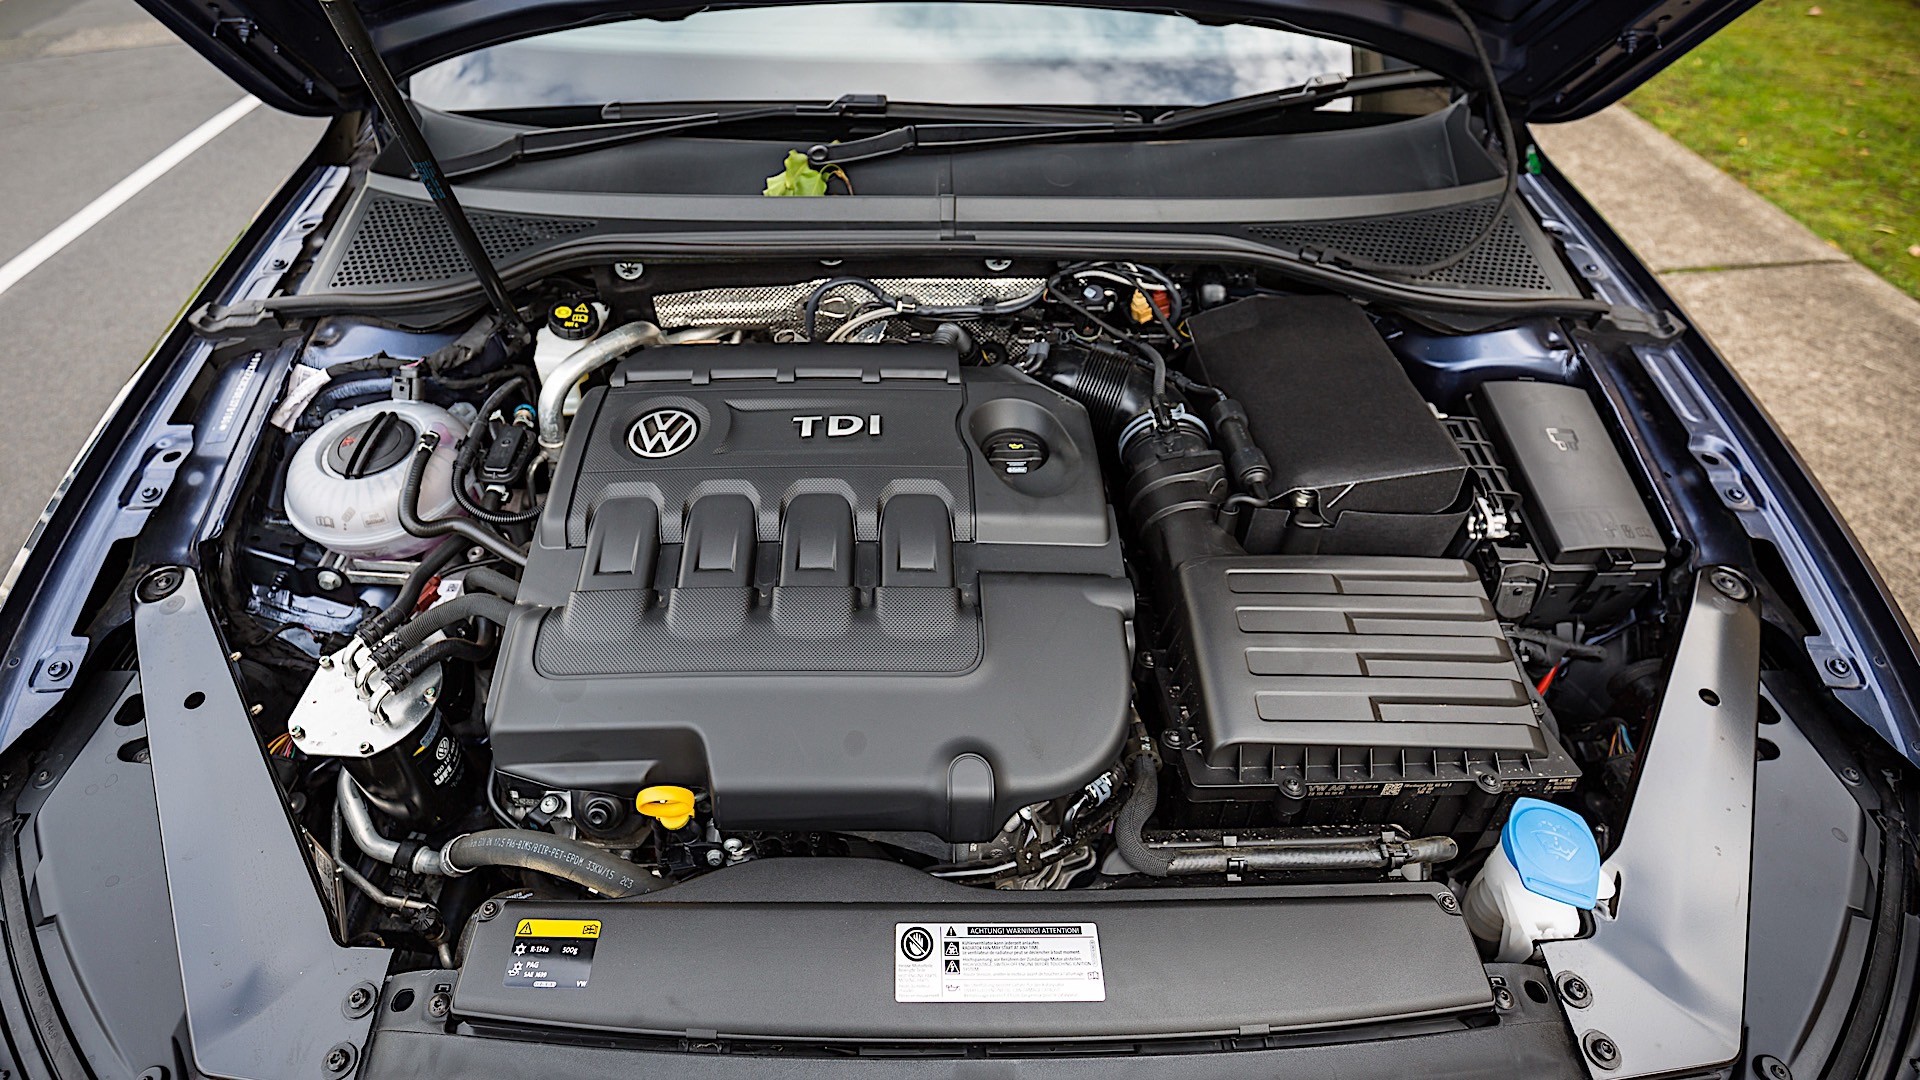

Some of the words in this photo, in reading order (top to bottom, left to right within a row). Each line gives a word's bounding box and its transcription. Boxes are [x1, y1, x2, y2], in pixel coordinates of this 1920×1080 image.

[792, 414, 881, 438] TDI
[434, 764, 452, 786] UFI
[970, 927, 1005, 935] ACHTUNG!
[1005, 927, 1041, 935] WARNING!
[529, 945, 550, 953] R-134a
[562, 946, 579, 955] 500g
[525, 961, 540, 969] PAG
[576, 980, 588, 988] VW
